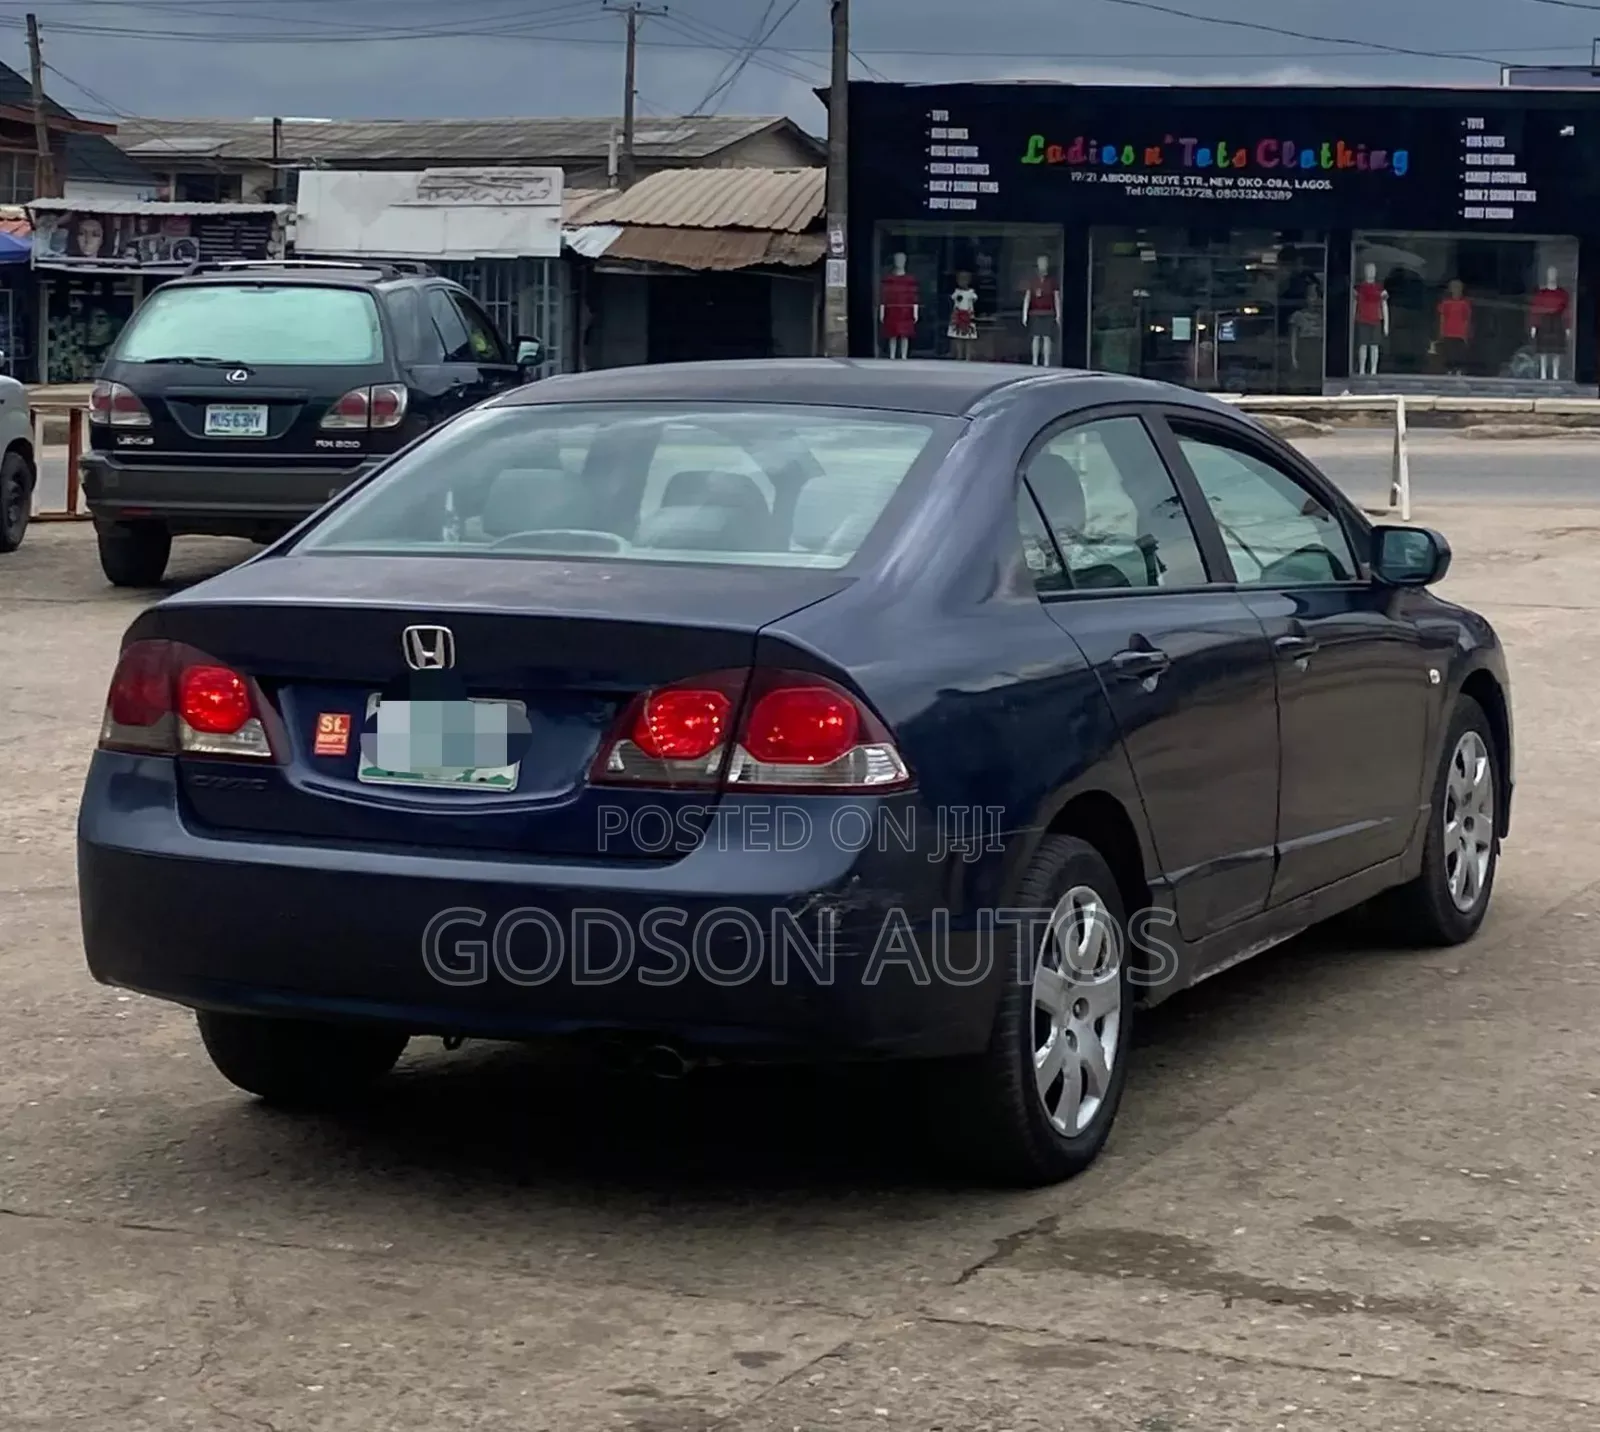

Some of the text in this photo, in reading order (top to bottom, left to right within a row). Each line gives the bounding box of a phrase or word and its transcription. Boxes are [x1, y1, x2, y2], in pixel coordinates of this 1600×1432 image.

[1021, 134, 1135, 165] Ladies
[1179, 137, 1247, 167] Tots
[1256, 138, 1409, 176] Clothing
[1151, 175, 1181, 185] KUYE
[1209, 176, 1234, 187] NEW
